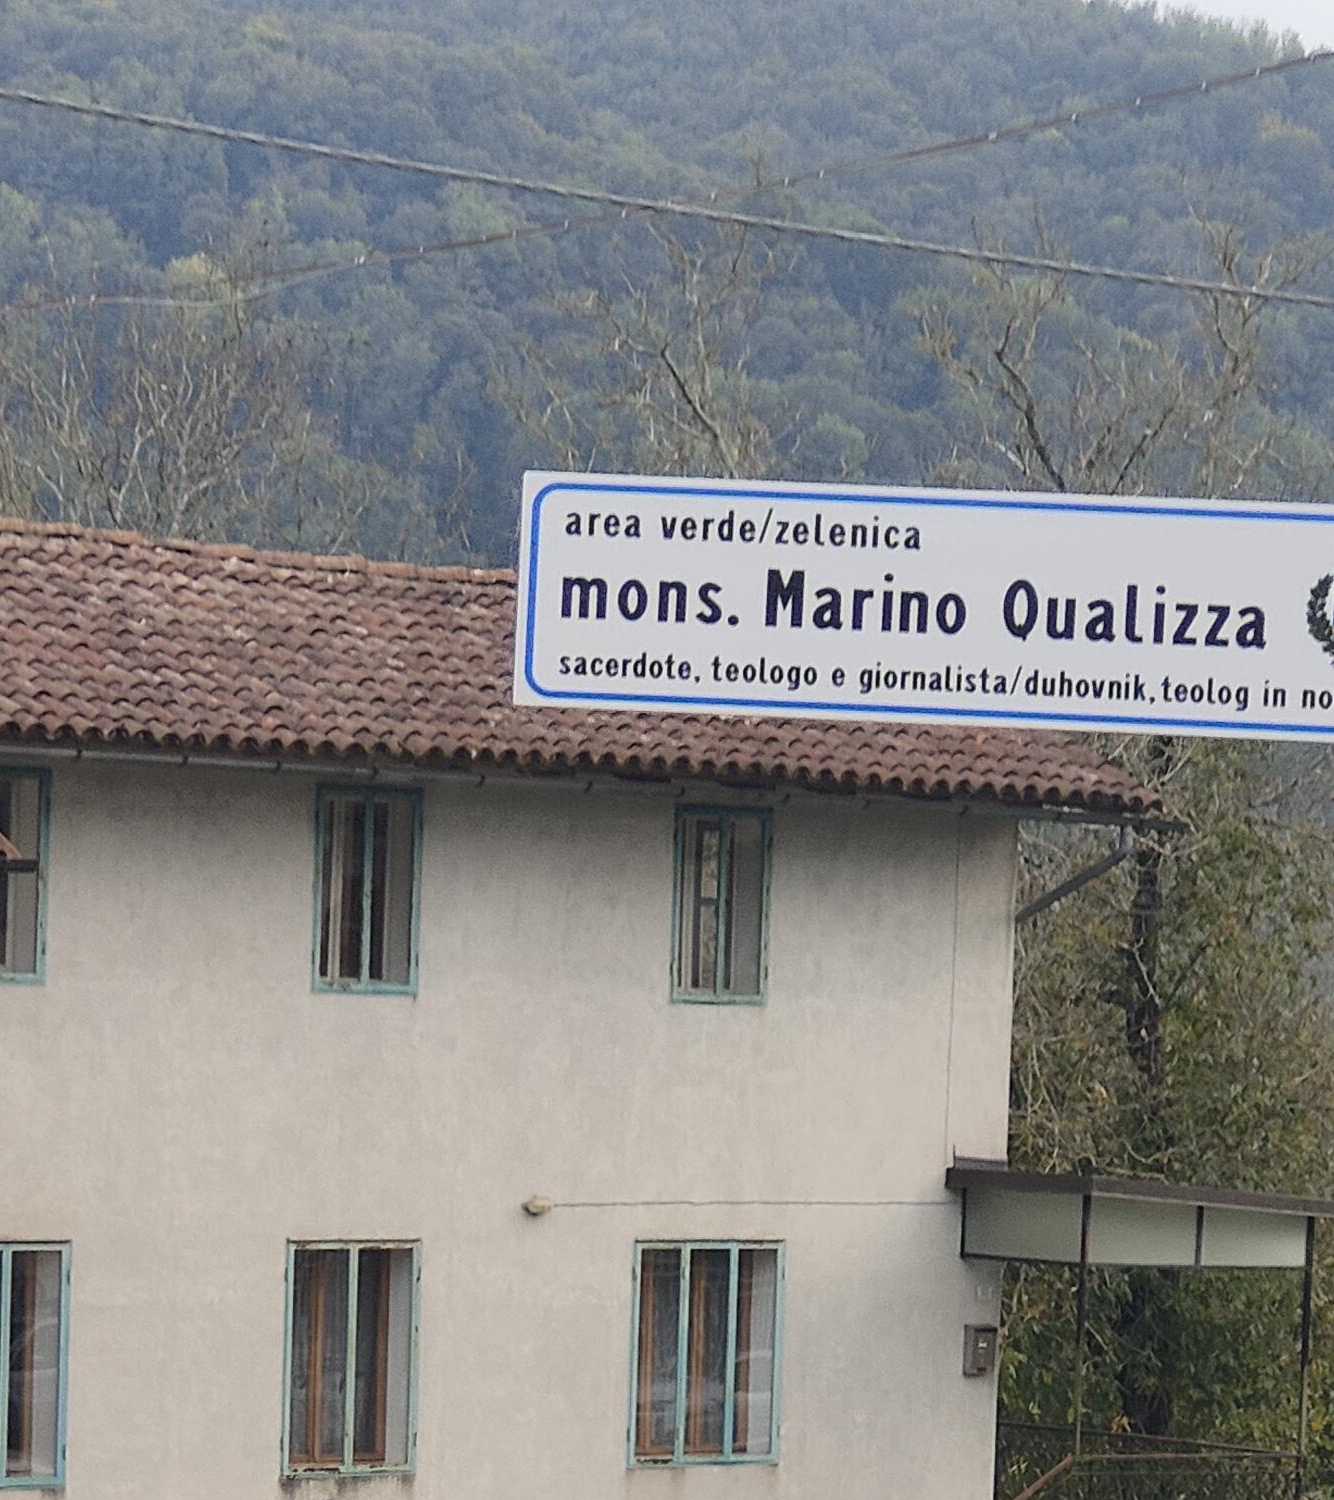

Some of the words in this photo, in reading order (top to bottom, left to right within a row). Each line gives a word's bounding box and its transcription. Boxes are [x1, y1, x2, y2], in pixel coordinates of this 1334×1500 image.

[565, 512, 641, 539] area
[660, 508, 921, 551] verde/zelenica
[561, 576, 740, 627] mons.
[764, 568, 967, 635] Marino
[1002, 579, 1267, 650] Qualizza
[559, 652, 701, 684] sacerdote,
[711, 655, 818, 691] teologo
[831, 667, 846, 687] e
[1263, 679, 1287, 708] in
